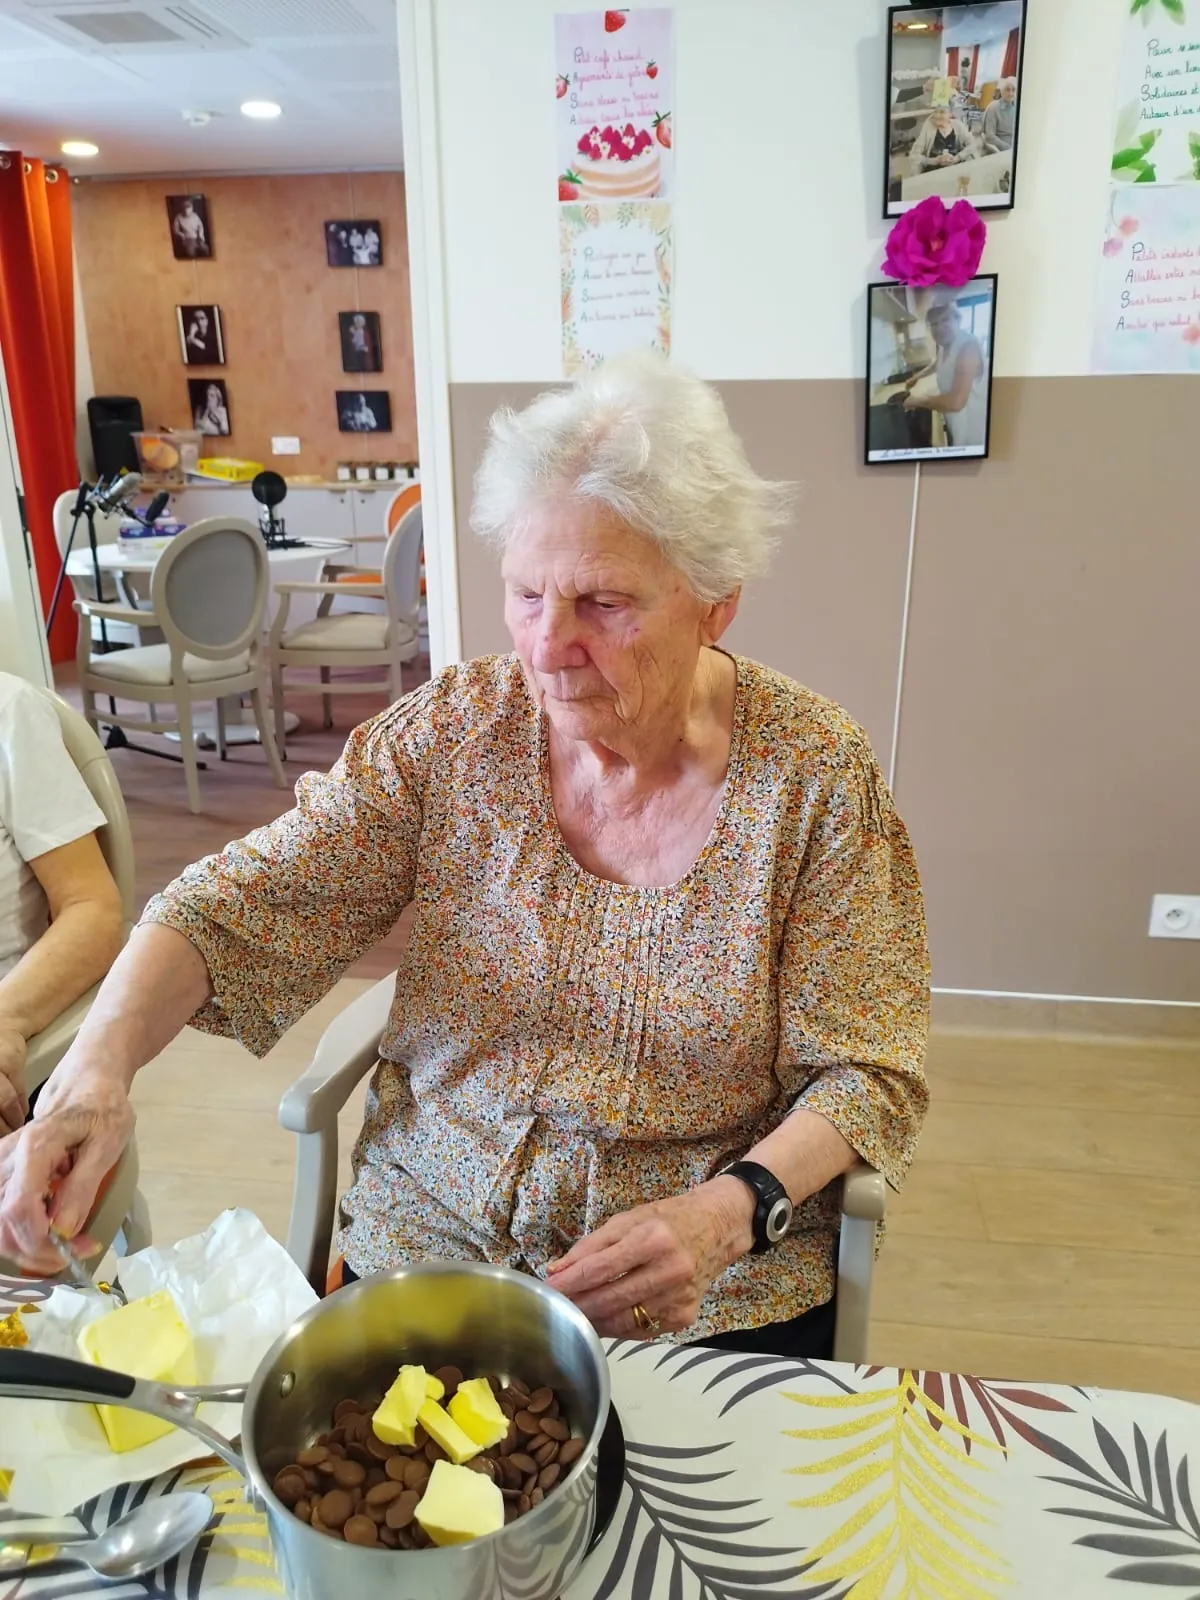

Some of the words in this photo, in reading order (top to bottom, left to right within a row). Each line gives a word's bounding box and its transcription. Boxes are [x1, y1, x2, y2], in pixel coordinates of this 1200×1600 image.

[1146, 38, 1173, 57] Pour
[1140, 83, 1187, 101] Solidaires
[1140, 106, 1171, 120] Autour
